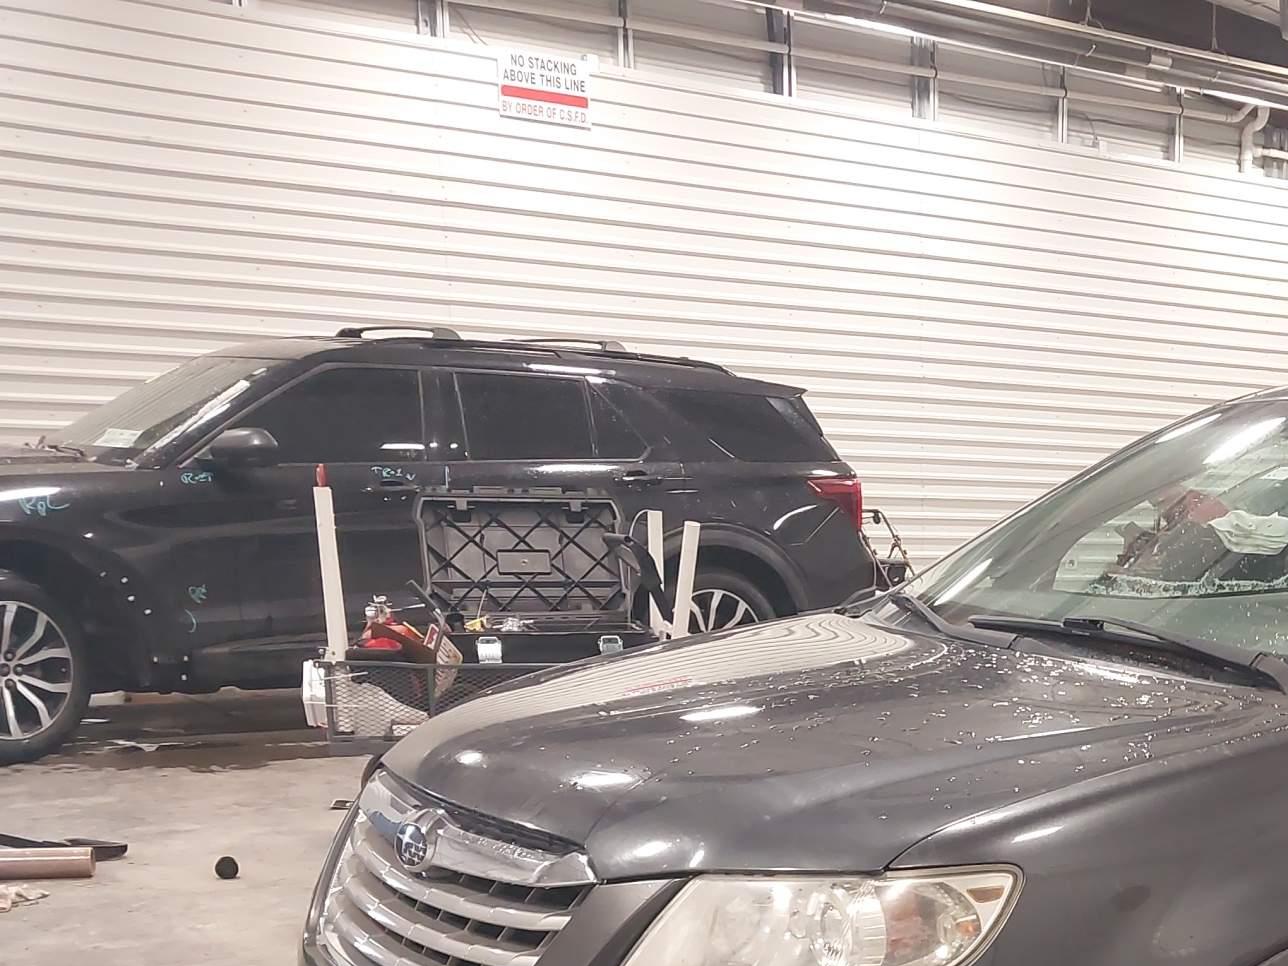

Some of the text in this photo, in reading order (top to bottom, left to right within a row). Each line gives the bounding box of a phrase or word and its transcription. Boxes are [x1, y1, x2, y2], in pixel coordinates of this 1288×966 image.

[510, 54, 577, 76] NO STACKING
[503, 69, 586, 93] ABOVE THIS LINE
[502, 100, 513, 112] BY
[515, 103, 543, 116] ORDER
[546, 106, 557, 119] OF
